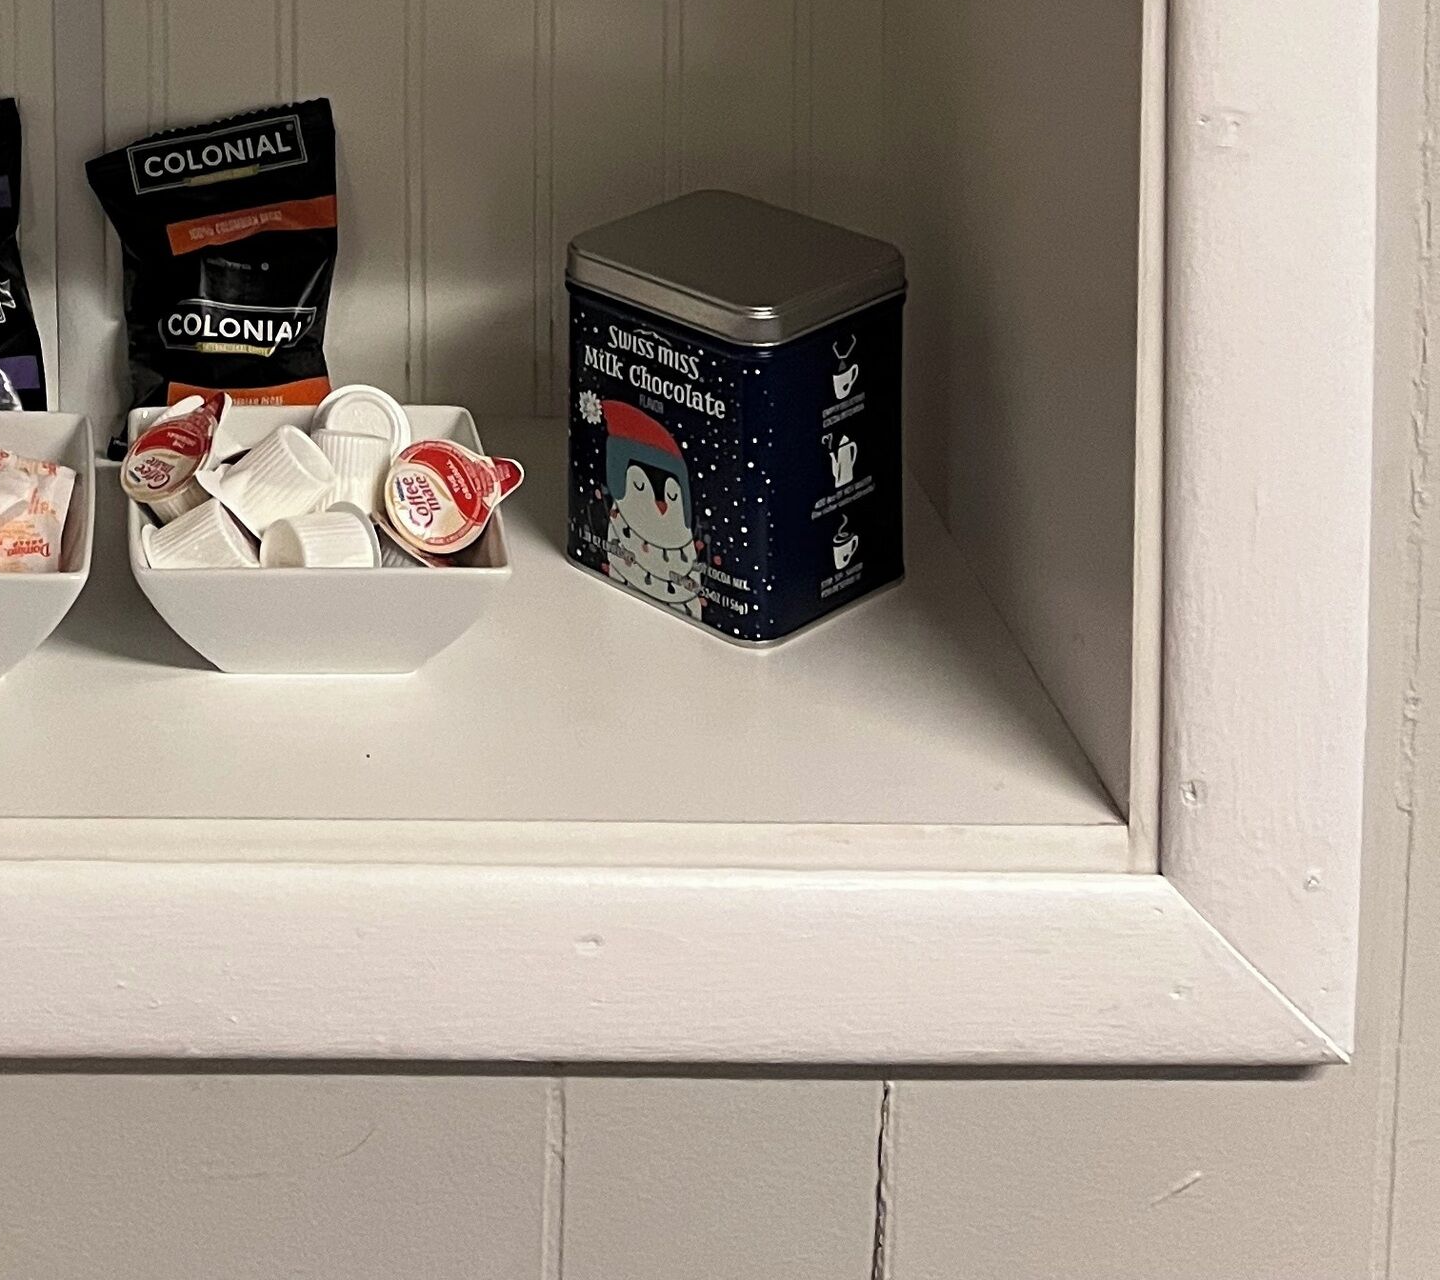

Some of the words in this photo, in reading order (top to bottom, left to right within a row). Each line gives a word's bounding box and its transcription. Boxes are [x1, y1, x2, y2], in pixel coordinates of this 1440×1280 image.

[144, 131, 293, 178] COLONIAL
[584, 344, 624, 381] Milk
[629, 364, 726, 420] Chocolate
[402, 476, 434, 529] Coffee
[415, 474, 442, 512] mate
